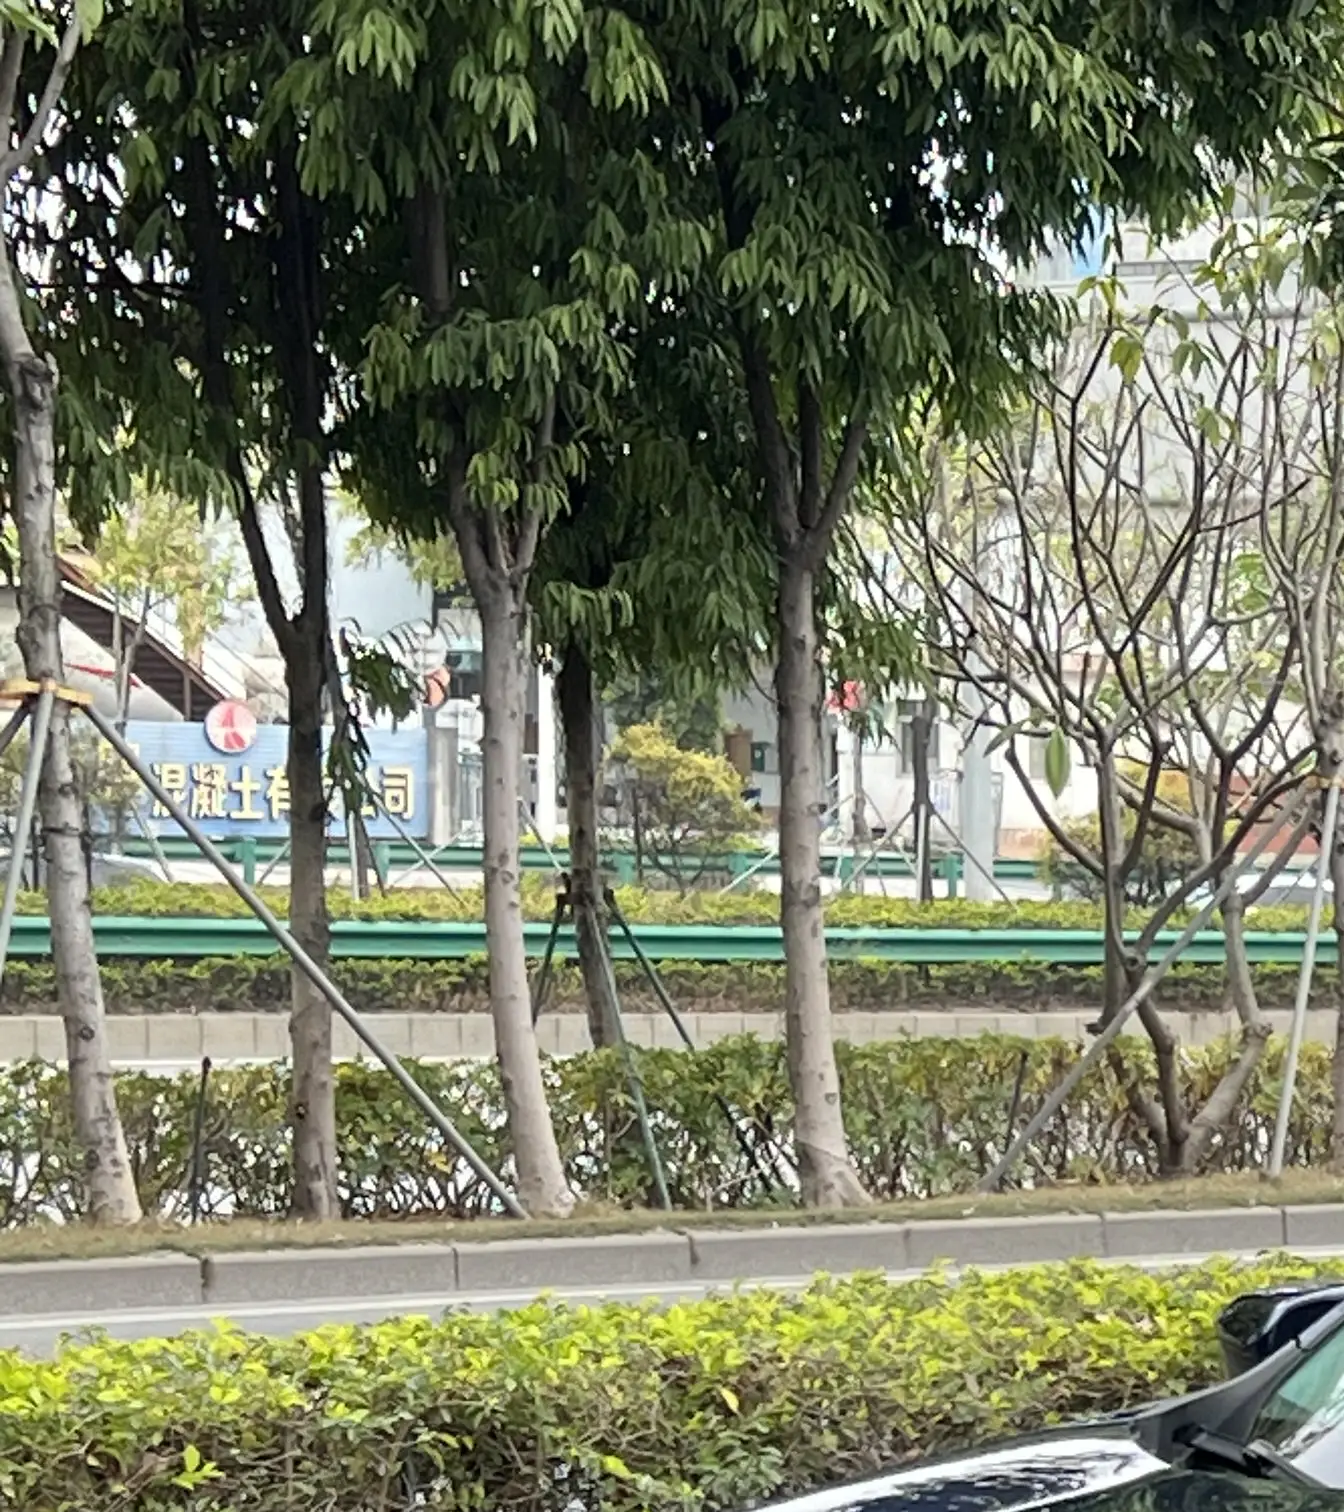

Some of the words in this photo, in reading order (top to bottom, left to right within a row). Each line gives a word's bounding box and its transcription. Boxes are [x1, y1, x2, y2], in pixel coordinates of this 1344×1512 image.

[152, 763, 415, 821] 混凝土有司
